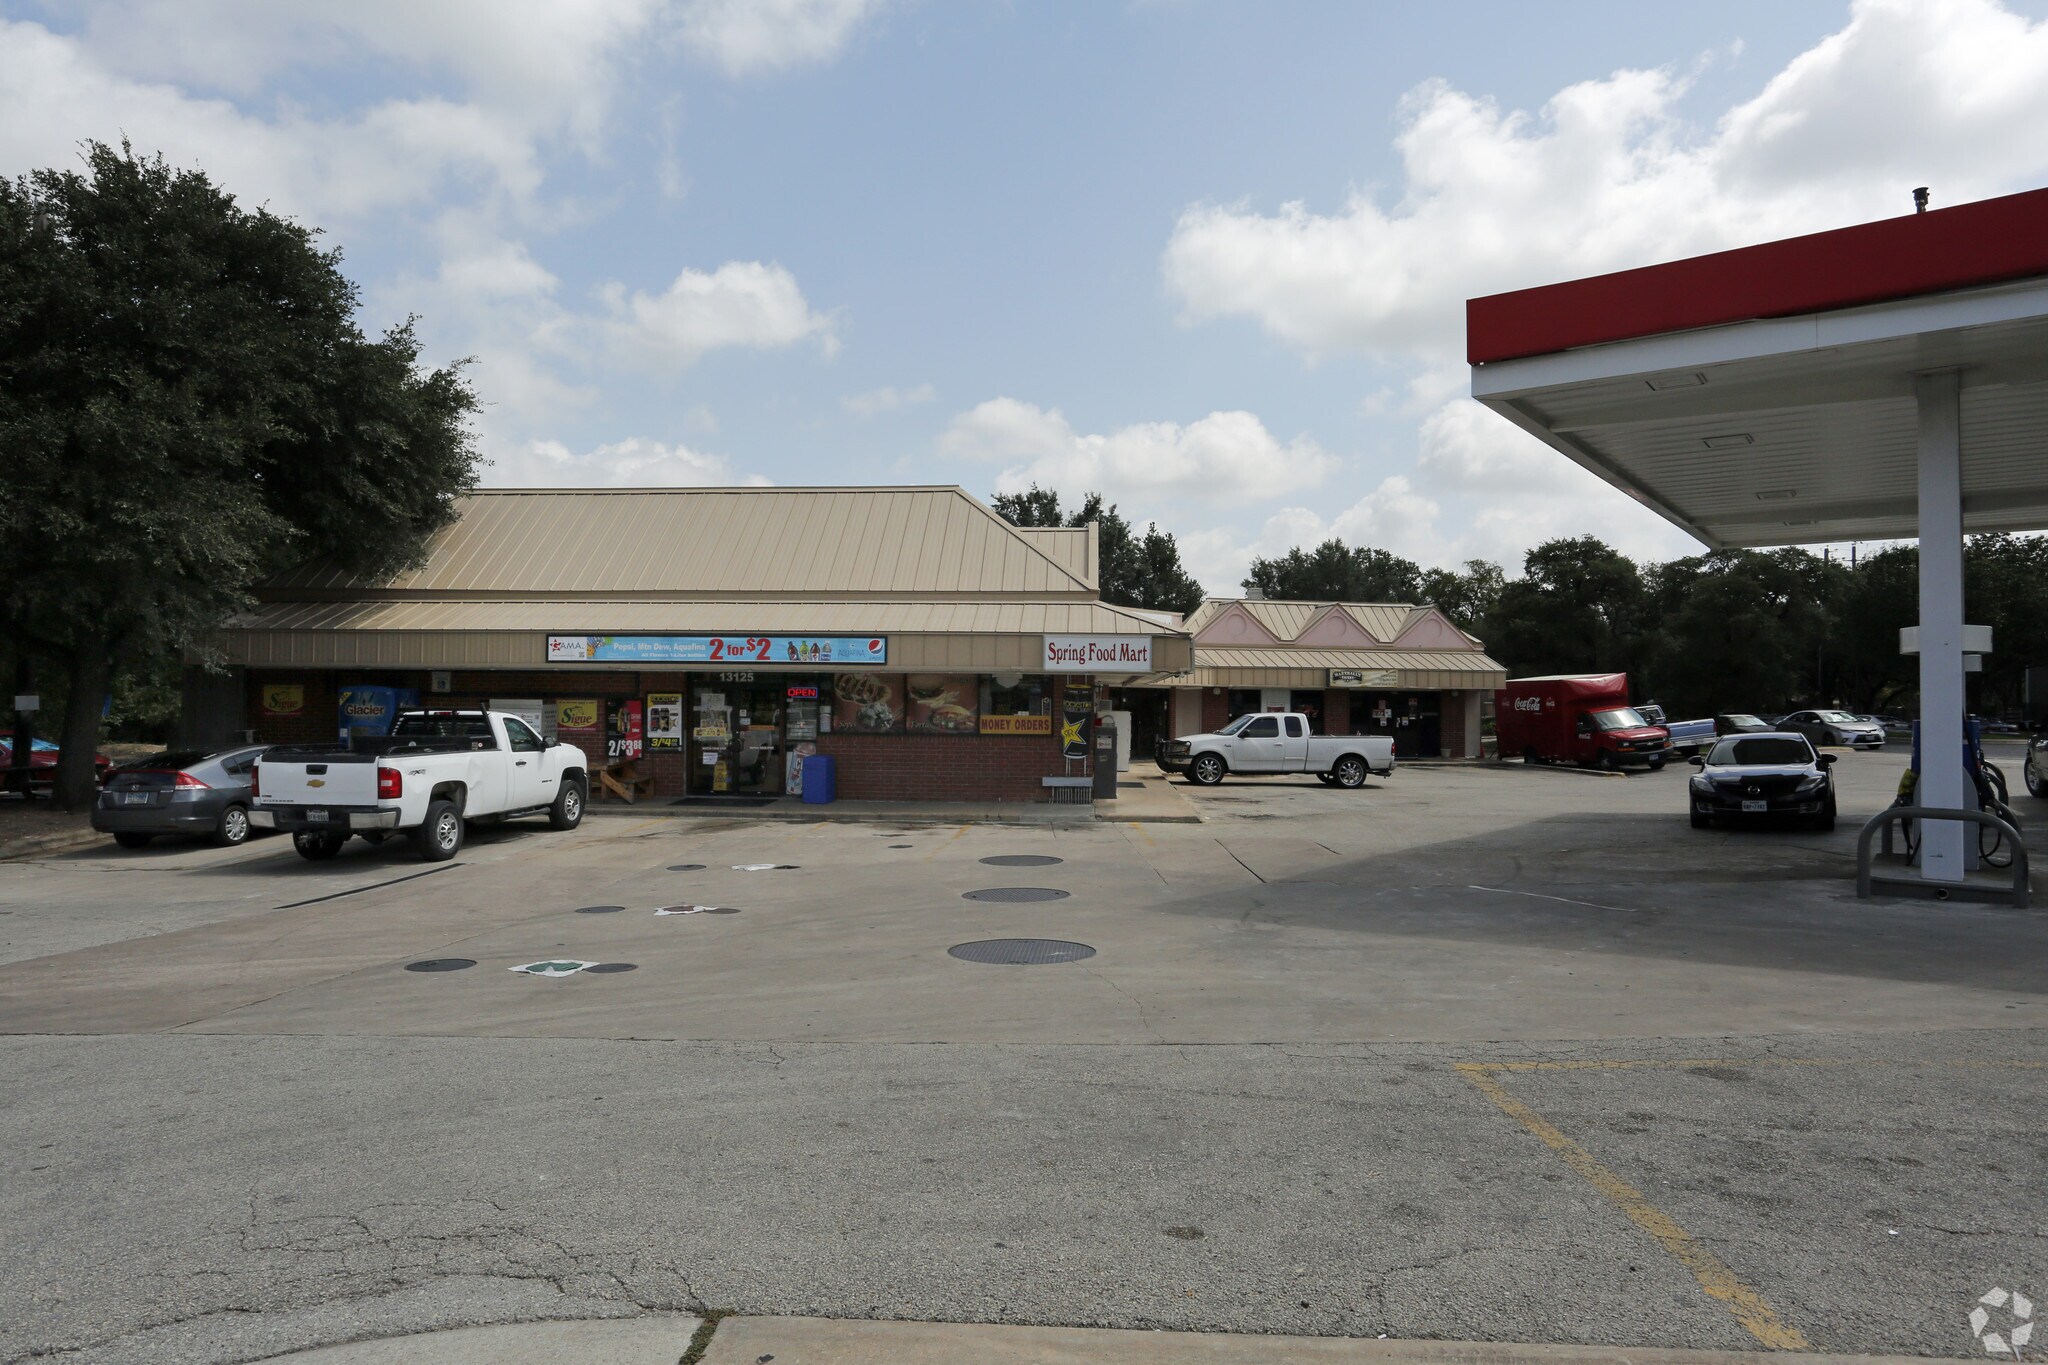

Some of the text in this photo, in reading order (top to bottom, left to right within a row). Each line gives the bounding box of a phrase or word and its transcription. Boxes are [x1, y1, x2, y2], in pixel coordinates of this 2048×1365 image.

[551, 641, 582, 650] GAMA
[613, 642, 706, 652] Pepsi, Mtn Dew, Aquafina
[709, 637, 771, 660] 2 for $2
[1048, 642, 1148, 664] Spring Food Mart
[719, 673, 754, 682] 13125
[788, 688, 816, 696] OPEN
[268, 692, 298, 710] Sigue
[345, 704, 384, 716] Glacier
[561, 707, 592, 727] Sigue
[981, 718, 1050, 731] MONEY ORDERS
